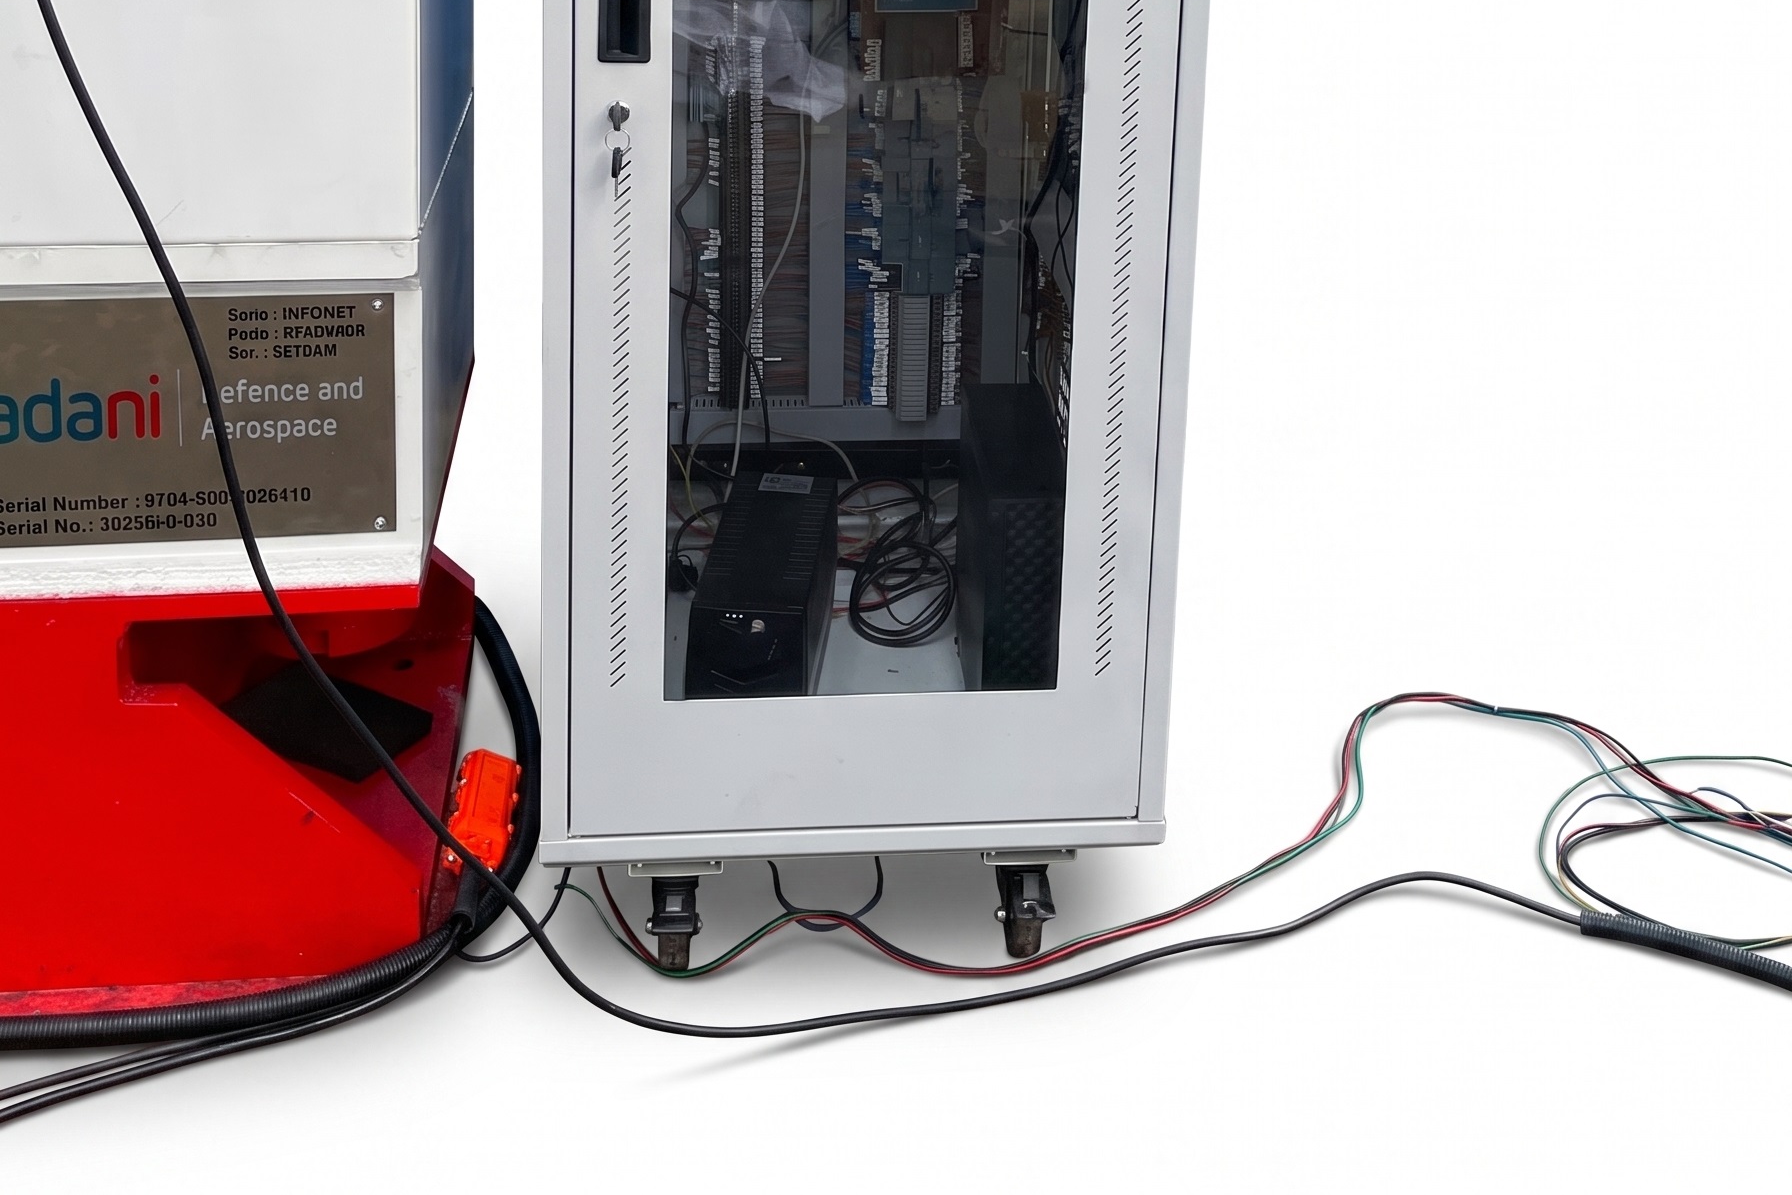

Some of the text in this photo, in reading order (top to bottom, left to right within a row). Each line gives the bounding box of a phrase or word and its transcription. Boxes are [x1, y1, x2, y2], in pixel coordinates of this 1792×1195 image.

[228, 308, 269, 321] Sorio
[282, 305, 356, 320] INFONET
[228, 346, 259, 359] Sor.
[273, 343, 337, 358] SETDAM
[202, 376, 363, 404] efence and
[0, 374, 161, 444] adani
[201, 417, 337, 443] Aerospace
[53, 495, 128, 511] Number
